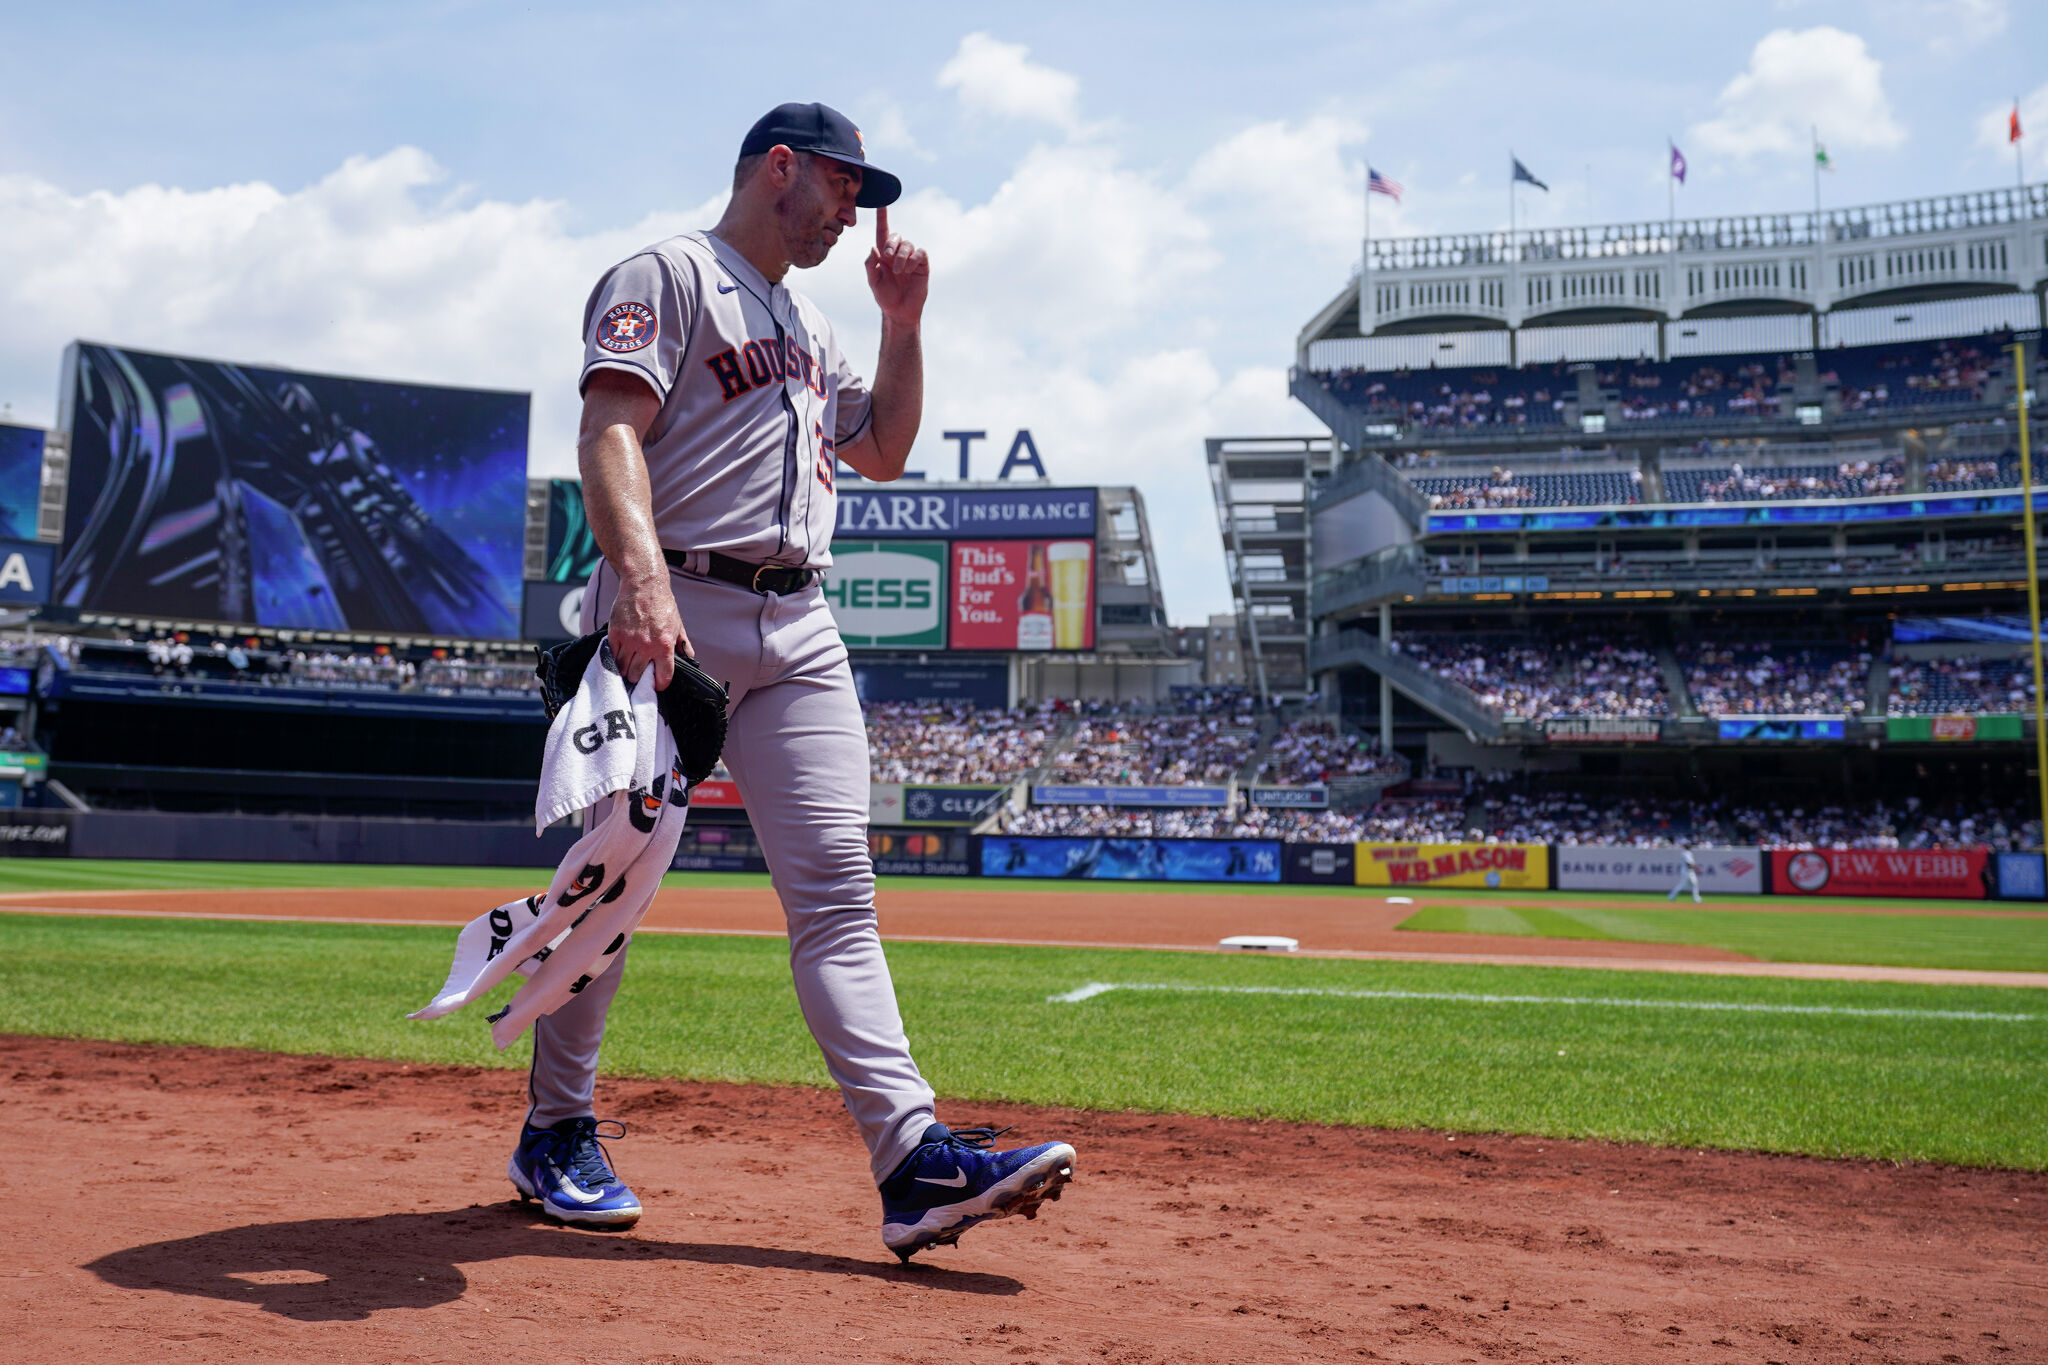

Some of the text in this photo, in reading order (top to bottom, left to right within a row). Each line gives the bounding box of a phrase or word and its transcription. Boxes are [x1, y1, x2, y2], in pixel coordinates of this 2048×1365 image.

[608, 304, 653, 321] HOUSTON
[603, 337, 642, 349] ASTROS
[962, 502, 1090, 521] INSURANCE
[958, 547, 1006, 566] This
[959, 567, 1015, 585] Bud's
[826, 579, 931, 609] HESS
[958, 586, 994, 604] For
[958, 606, 1002, 623] You.
[1562, 862, 1606, 875] BANK
[1612, 862, 1632, 875] OF
[1886, 856, 1969, 878] WEBB
